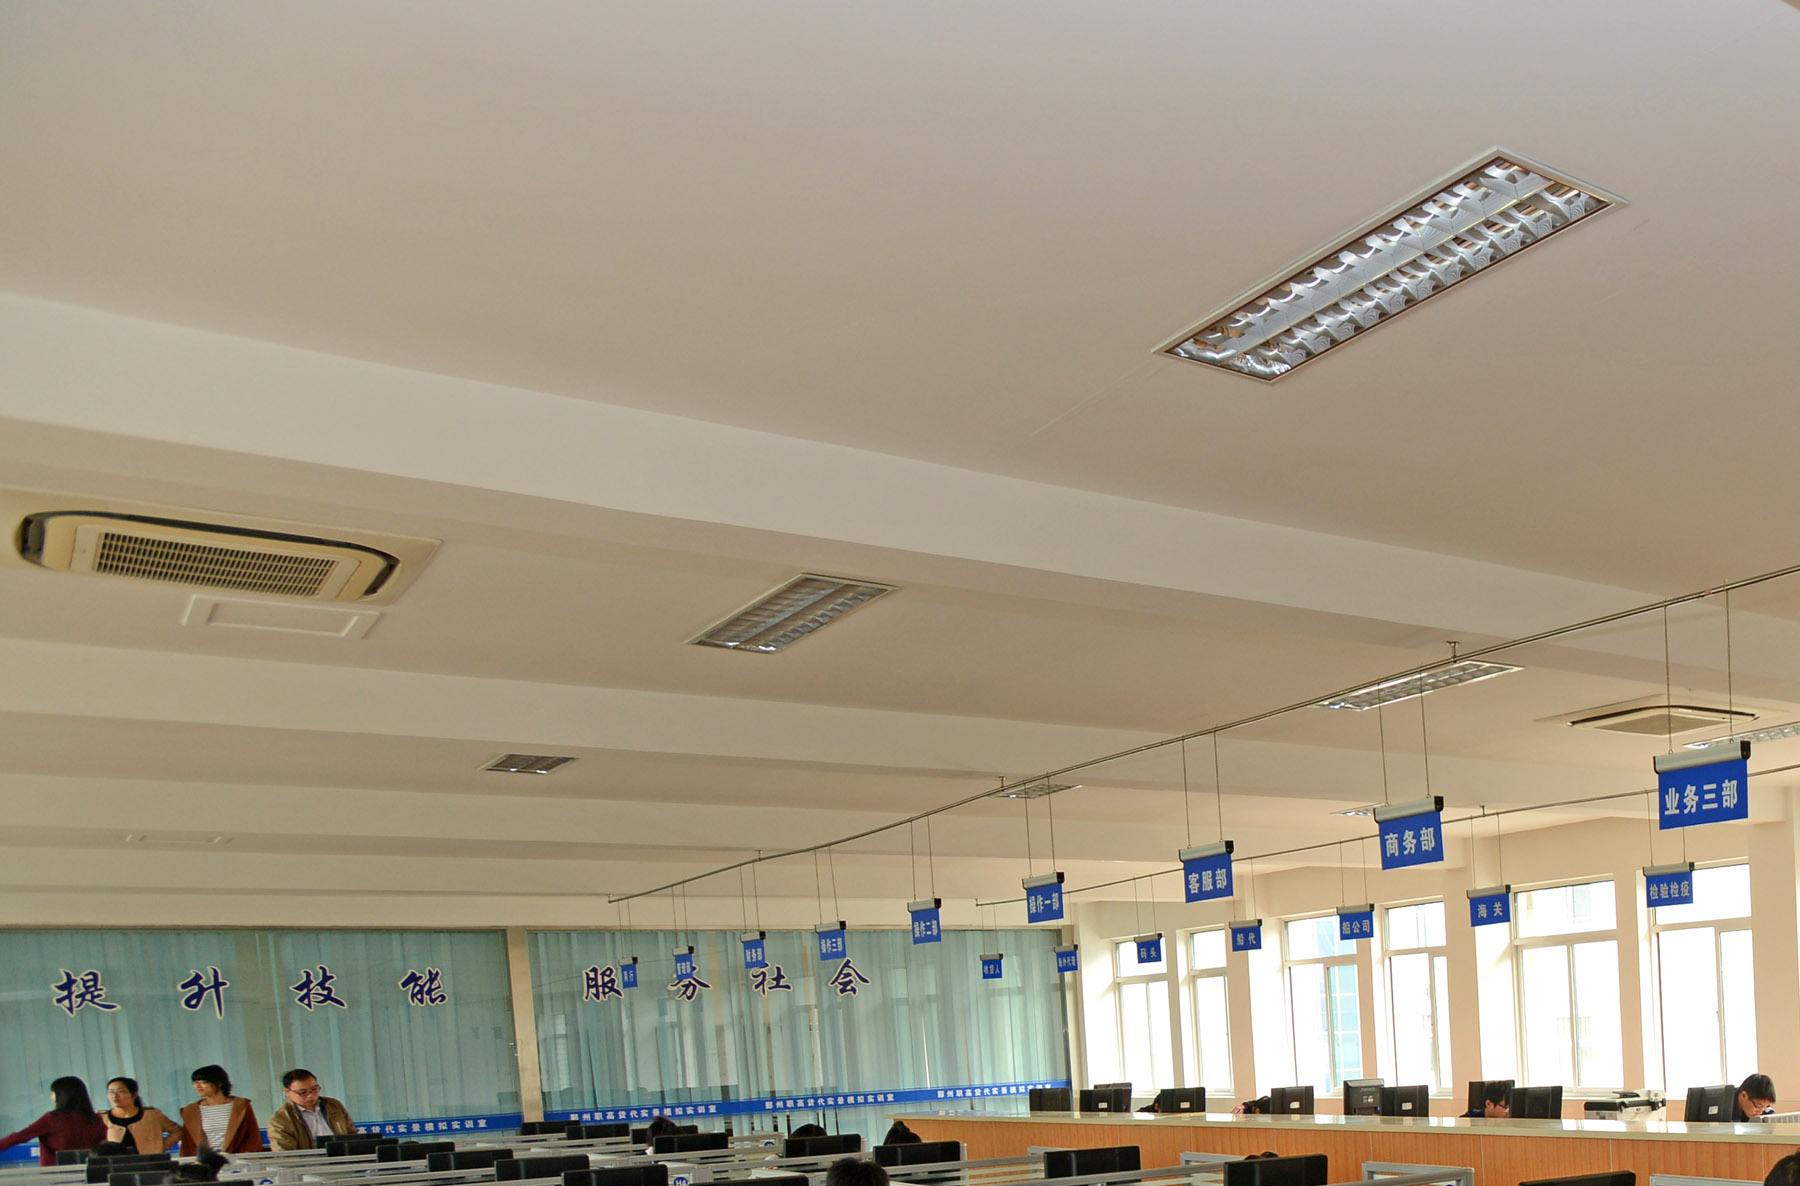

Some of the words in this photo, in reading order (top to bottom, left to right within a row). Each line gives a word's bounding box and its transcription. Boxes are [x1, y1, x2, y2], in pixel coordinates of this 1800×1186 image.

[1665, 779, 1738, 815] 业务三部
[1385, 827, 1435, 857] 商务部
[1188, 868, 1227, 894] 客服部
[1650, 881, 1689, 899] 检验检疫
[1478, 901, 1503, 918] 海关
[1342, 919, 1370, 934] 船公司
[53, 965, 448, 1018] 提升技能
[582, 958, 870, 1001] 服务社会
